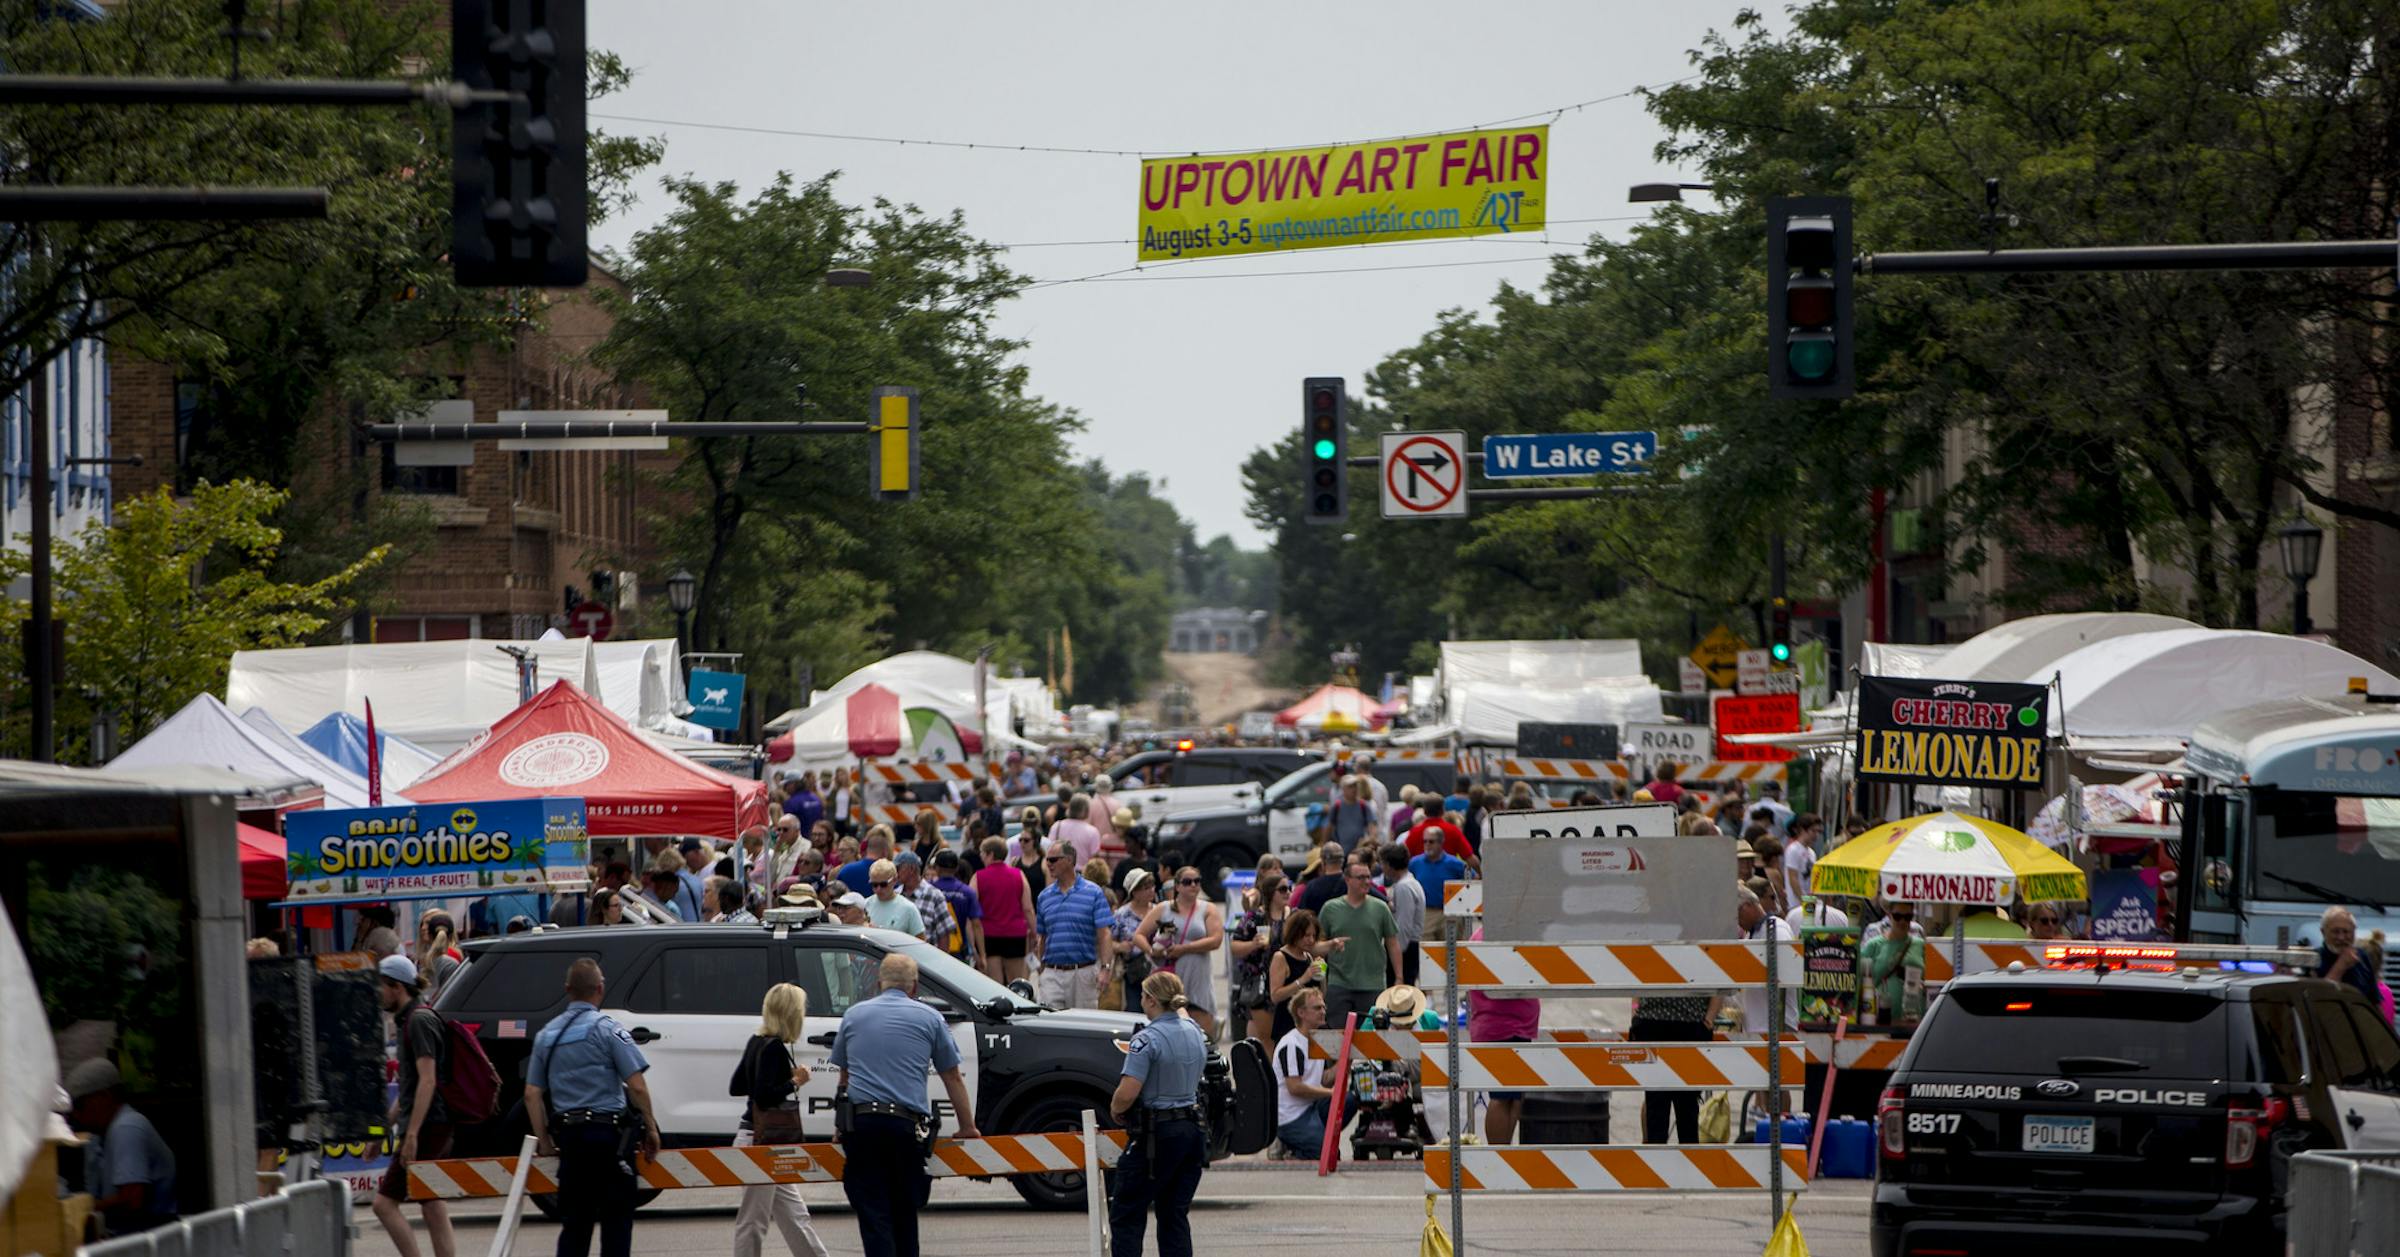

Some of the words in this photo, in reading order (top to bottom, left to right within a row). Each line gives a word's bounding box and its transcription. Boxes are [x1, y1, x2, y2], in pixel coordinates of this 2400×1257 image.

[1144, 153, 1329, 211] UPTOWN
[1334, 143, 1429, 196] ART
[1440, 133, 1541, 187] FAIR
[1143, 224, 1213, 257] August
[1218, 218, 1252, 247] 3-5
[1258, 202, 1460, 249] uptownartfair.com
[1495, 445, 1521, 469] W
[1530, 443, 1602, 468] Lake
[1611, 441, 1647, 467] St
[1932, 684, 1976, 699] JERRY'S
[1892, 698, 2012, 730] CHERRY
[1641, 730, 1695, 749] ROAD
[1860, 729, 2041, 783] LEMONADE
[617, 804, 664, 815] INDEED
[349, 818, 417, 836] BAJA
[544, 823, 587, 845] Smoothies
[319, 827, 512, 875] Smoothies
[365, 877, 395, 890] WITH
[398, 876, 429, 889] REAL
[431, 873, 470, 889] FRUIT!
[1820, 865, 1870, 894] LEMONADE
[1901, 873, 1996, 902] LEMONADE
[2026, 872, 2080, 901] LEMONADE
[2121, 896, 2140, 908] Ask
[2113, 907, 2140, 919] about
[2095, 918, 2156, 936] SPECIA
[1804, 971, 1857, 991] LEMONADE
[985, 1034, 1012, 1048] T1
[1910, 1083, 2021, 1100] MINNEAPOLIS
[2095, 1088, 2207, 1106] POLICE
[1908, 1113, 1961, 1134] 8517
[2030, 1125, 2090, 1145] POLICE
[345, 1174, 374, 1191] EAL
